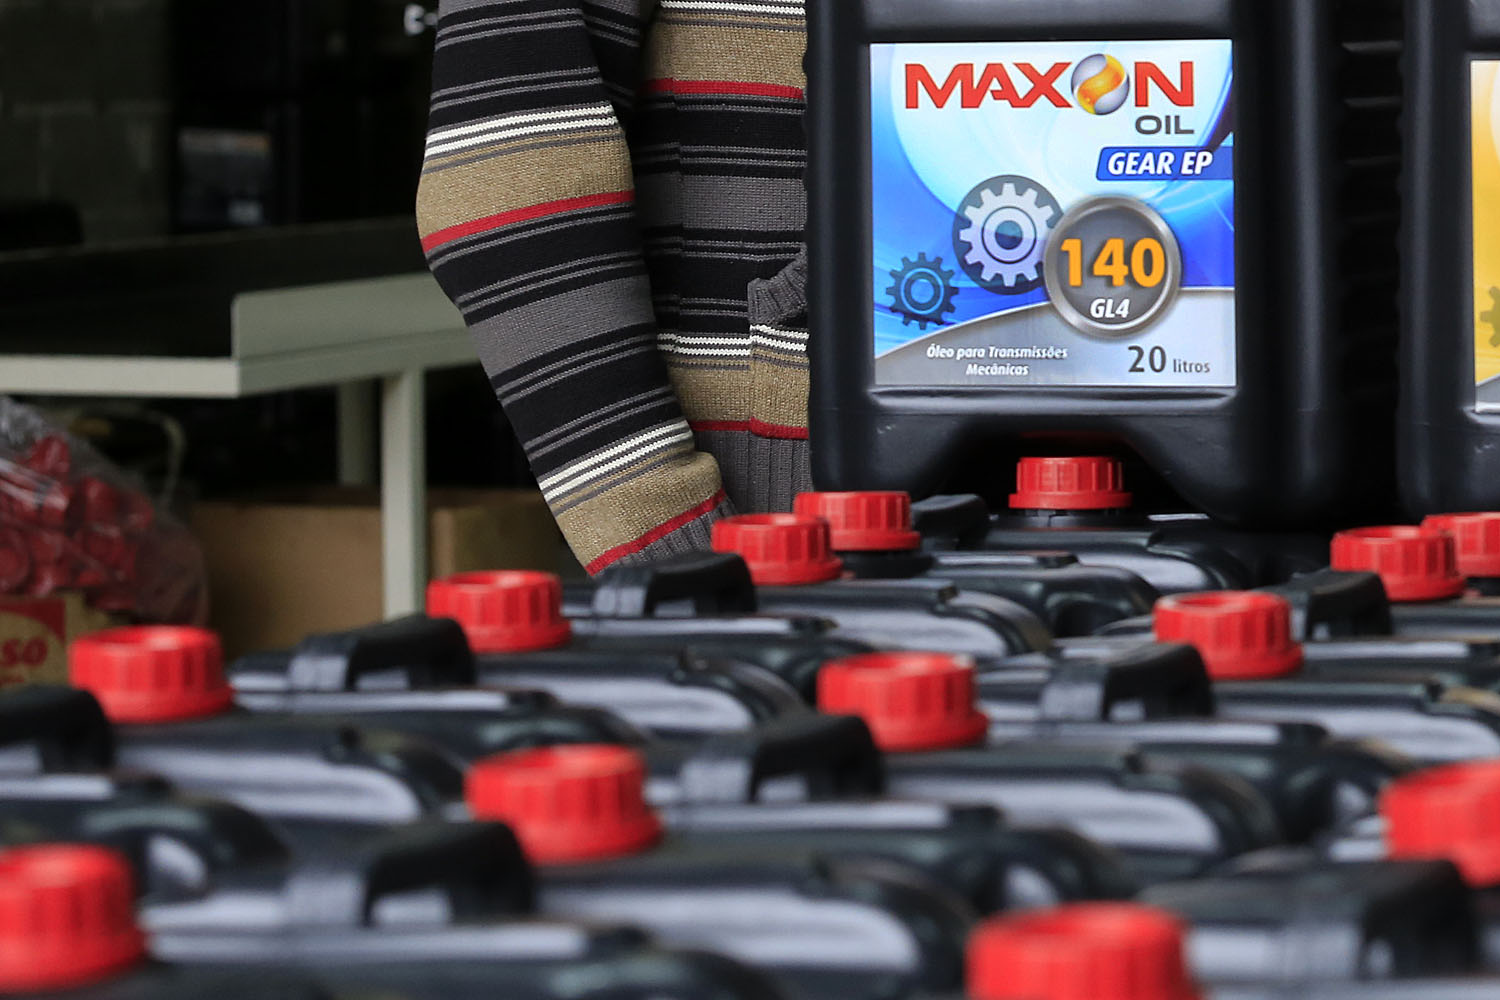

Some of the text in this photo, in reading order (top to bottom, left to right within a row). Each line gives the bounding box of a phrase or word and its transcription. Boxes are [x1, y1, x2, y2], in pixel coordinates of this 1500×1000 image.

[905, 52, 1195, 116] MAXON
[1134, 115, 1195, 135] OIL
[1107, 150, 1214, 175] GEAR EP
[1060, 237, 1166, 288] 140
[1089, 298, 1131, 319] GL4
[926, 343, 1068, 361] Óleo para Transmissões
[1127, 345, 1212, 374] 20 litros
[965, 362, 1030, 377] Mecânicas
